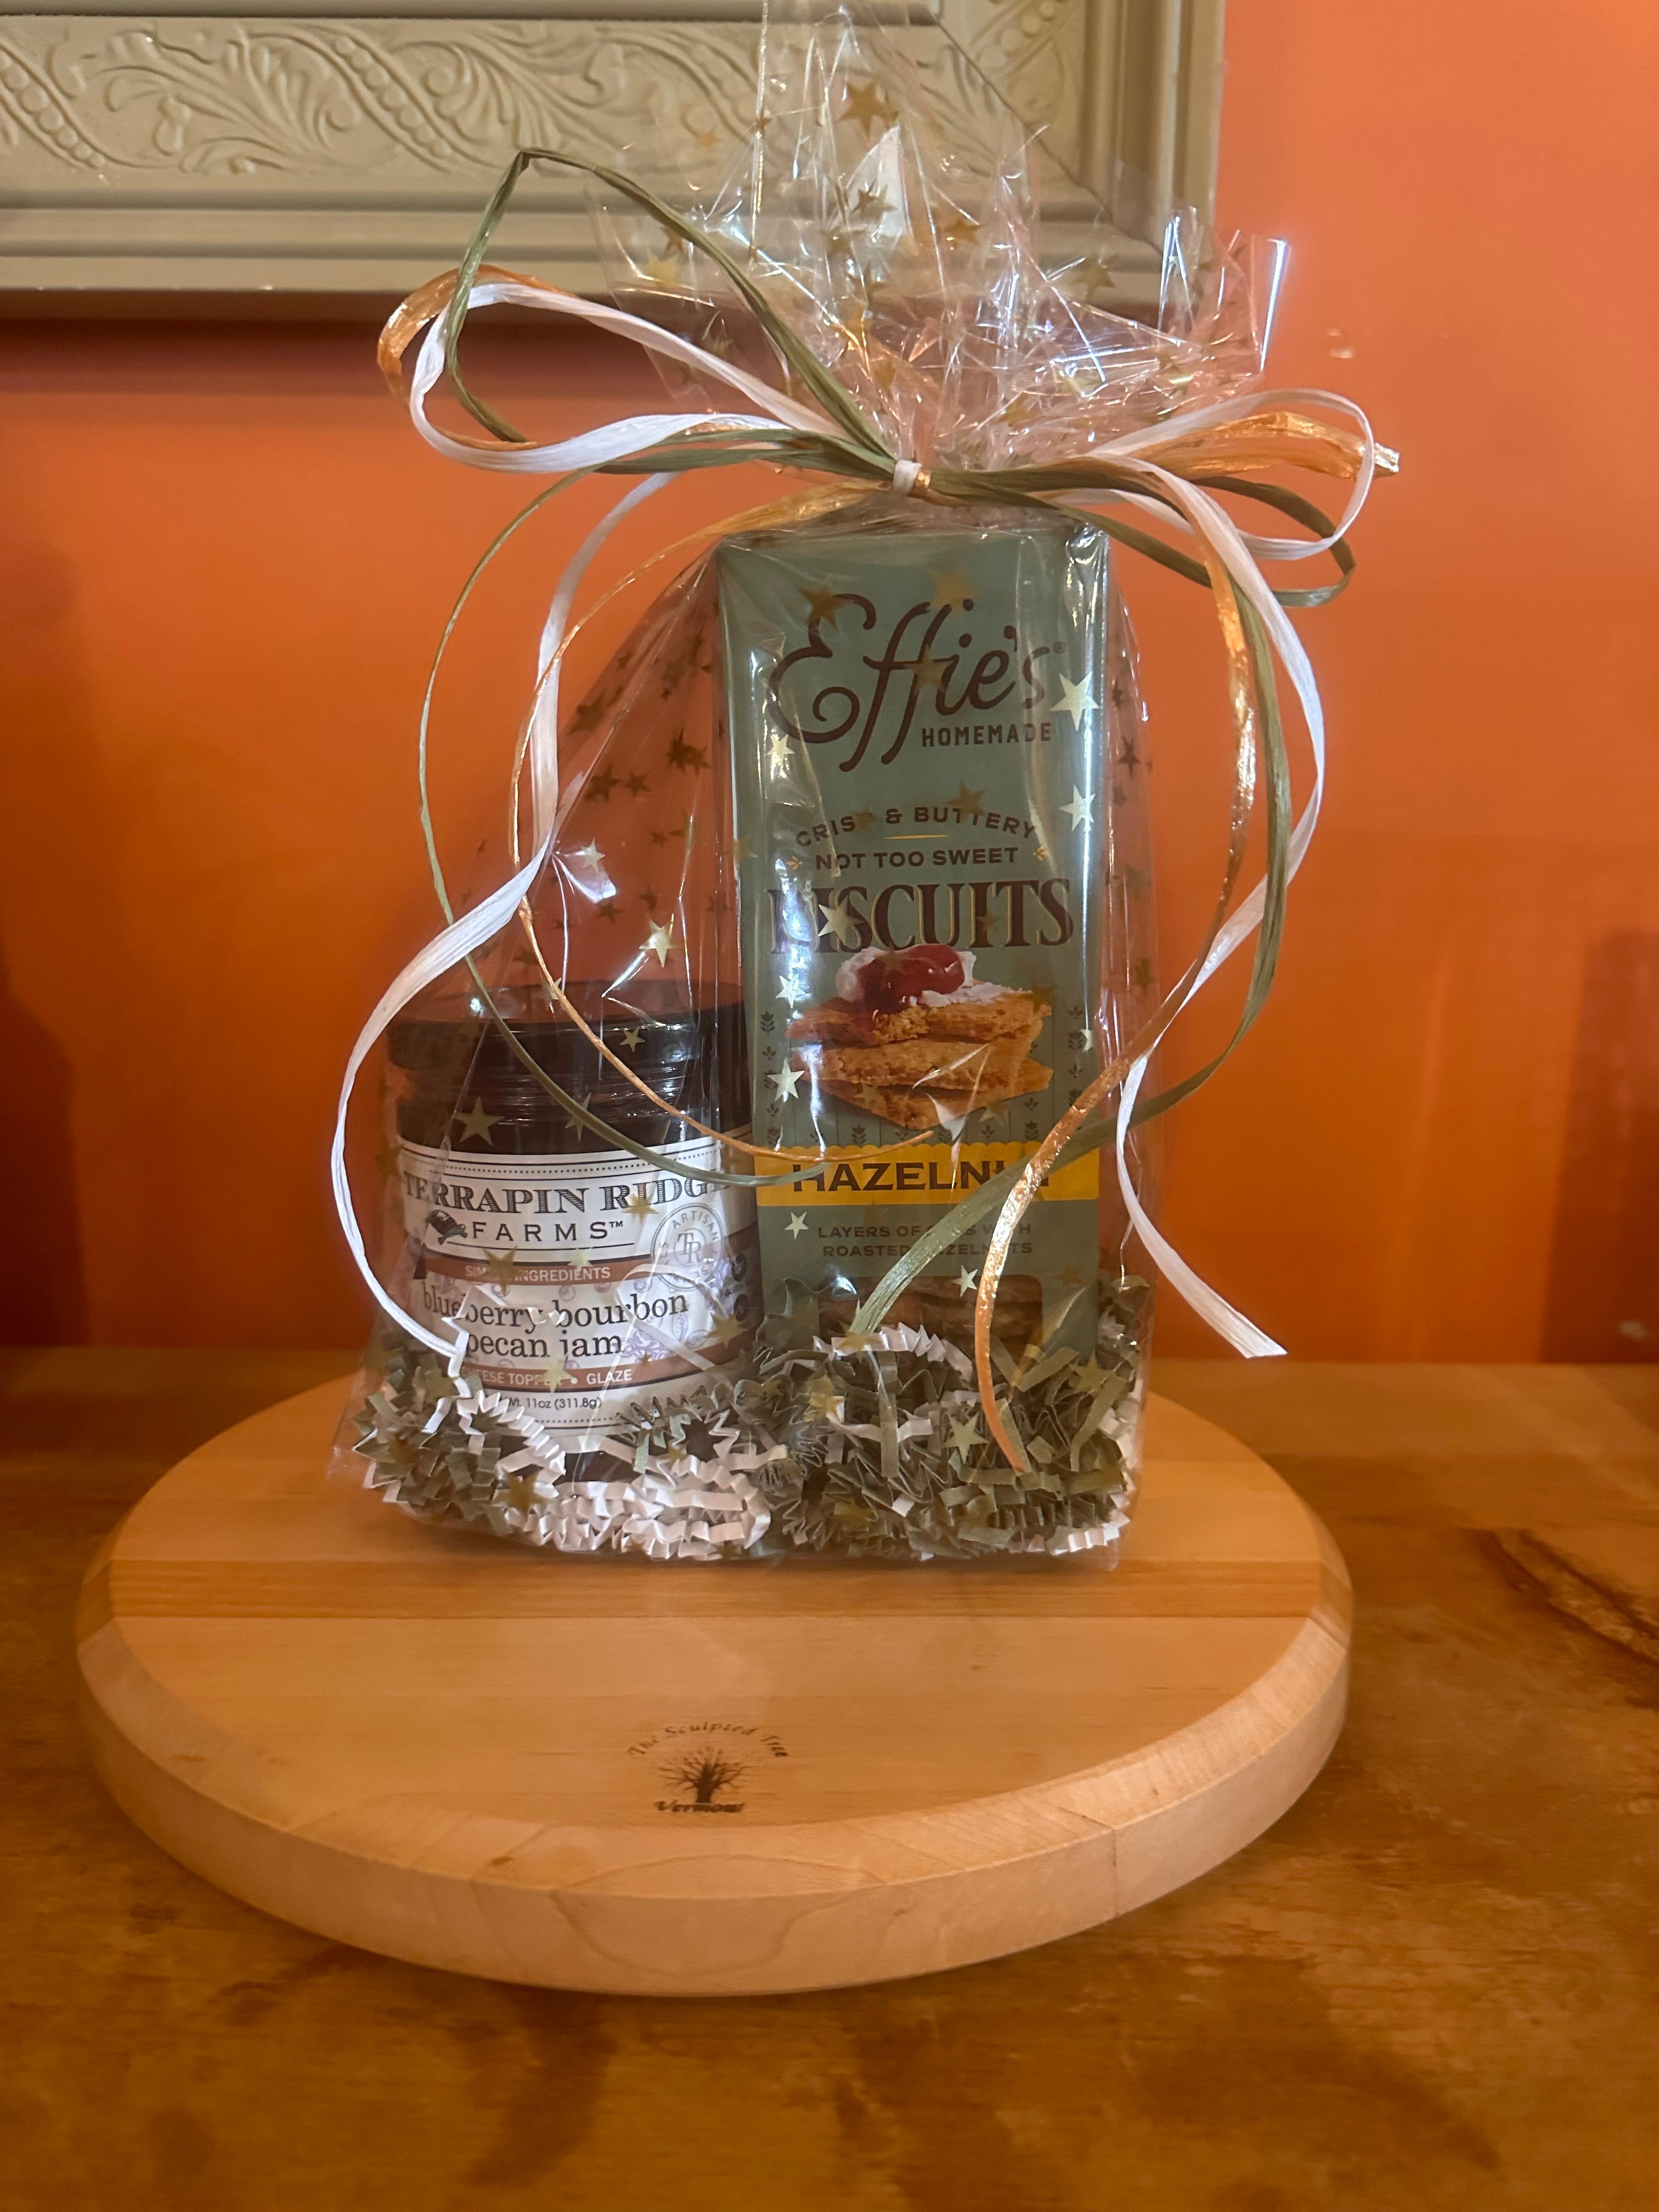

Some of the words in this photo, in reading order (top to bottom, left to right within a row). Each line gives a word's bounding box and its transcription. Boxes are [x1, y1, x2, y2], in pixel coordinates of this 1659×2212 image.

[922, 722, 1051, 747] HOMEMADE
[795, 812, 872, 847] CRIS
[885, 808, 903, 823] &
[915, 806, 1035, 839] BUTTERY
[816, 853, 866, 870] NOT
[874, 851, 924, 868] TOO
[933, 847, 1019, 866] SWEET
[793, 1160, 1049, 1192] HAZELN
[403, 1170, 588, 1214] TERRAPIN
[599, 1177, 729, 1211] RIDG
[672, 1210, 719, 1242] ARTISAN
[817, 1226, 890, 1238] LAYERS
[896, 1224, 921, 1238] OF
[822, 1244, 911, 1257] ROASTED
[551, 1292, 689, 1328] bourbon
[465, 1333, 551, 1358] pecan
[560, 1330, 624, 1362] jam
[586, 1369, 633, 1385] GLAZE
[526, 1397, 552, 1408] 11oz
[554, 1397, 602, 1410] (311.8g)
